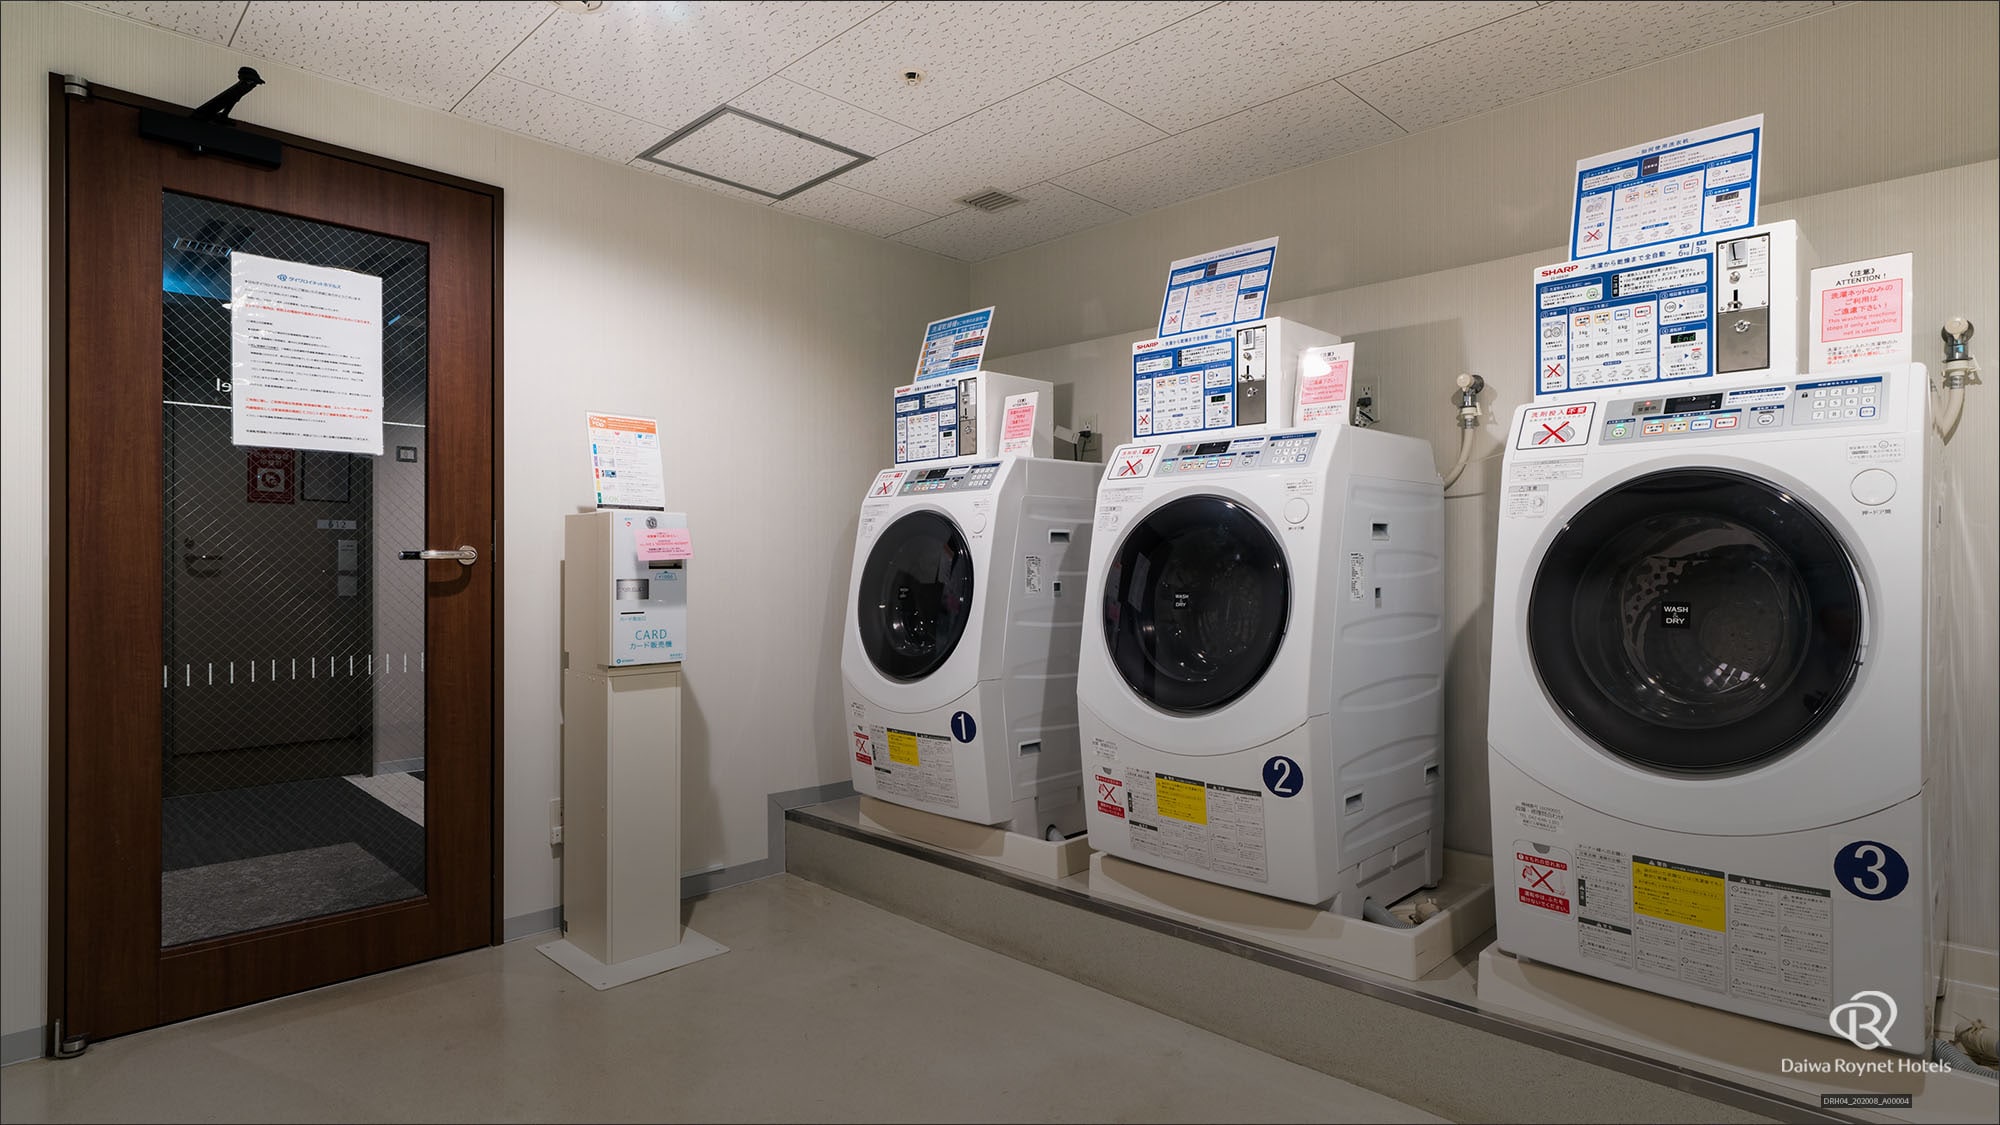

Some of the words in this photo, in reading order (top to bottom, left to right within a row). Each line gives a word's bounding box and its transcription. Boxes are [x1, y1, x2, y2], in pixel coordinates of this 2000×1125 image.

[1541, 264, 1579, 277] SHARP
[635, 628, 667, 641] CARD
[957, 713, 967, 740] 1
[1273, 759, 1293, 793] 2
[1853, 844, 1888, 895] 3
